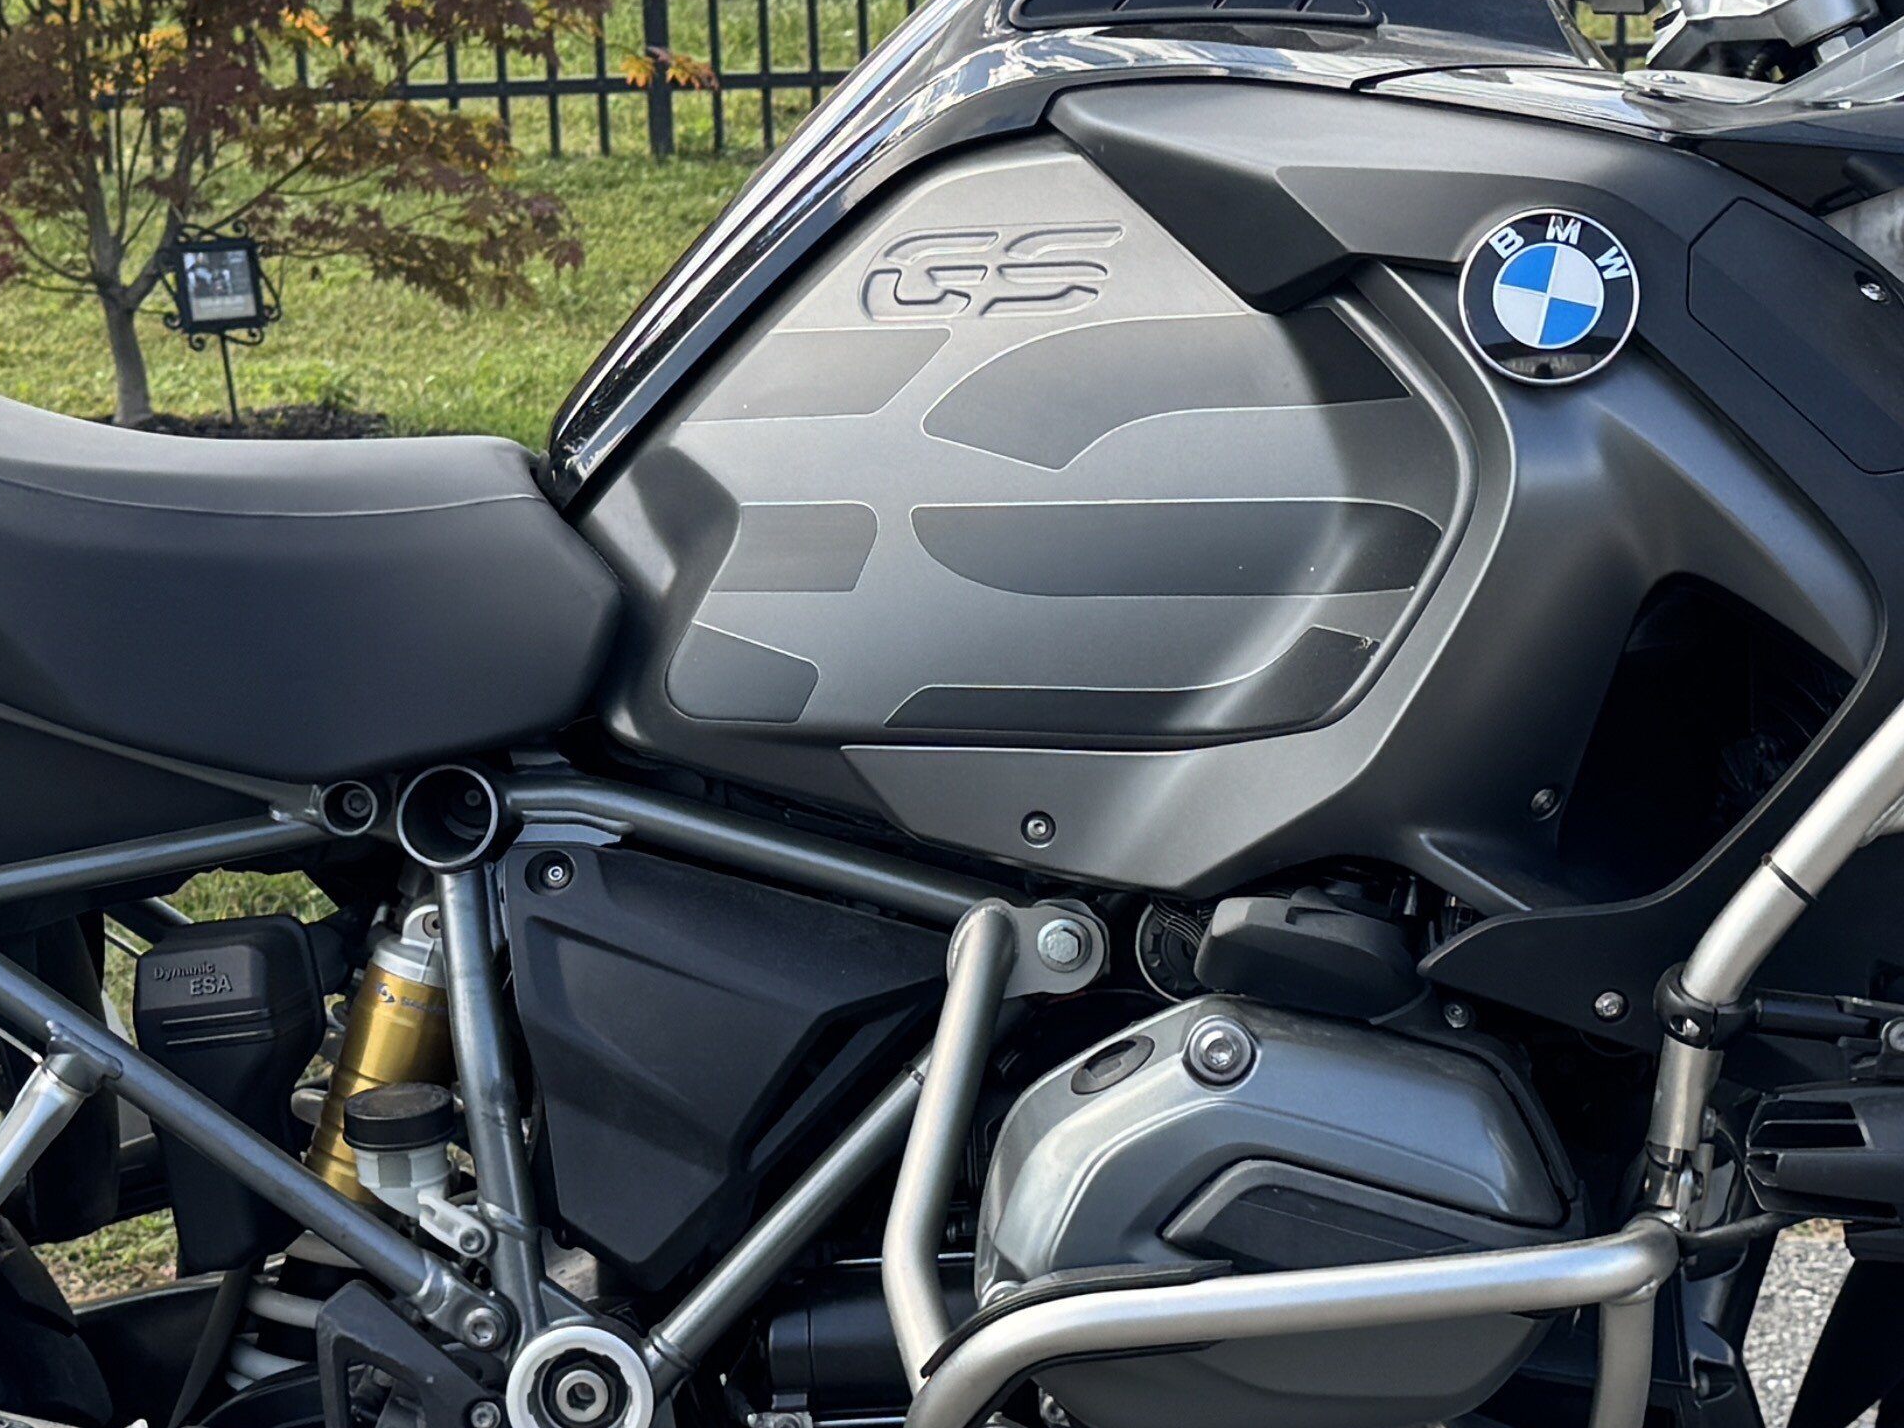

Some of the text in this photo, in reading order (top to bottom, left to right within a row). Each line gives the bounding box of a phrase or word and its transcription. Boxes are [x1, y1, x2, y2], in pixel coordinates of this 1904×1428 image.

[1489, 215, 1630, 280] BMW
[860, 224, 1125, 321] GS
[154, 961, 216, 982] Dynamic
[190, 974, 234, 997] ESA
